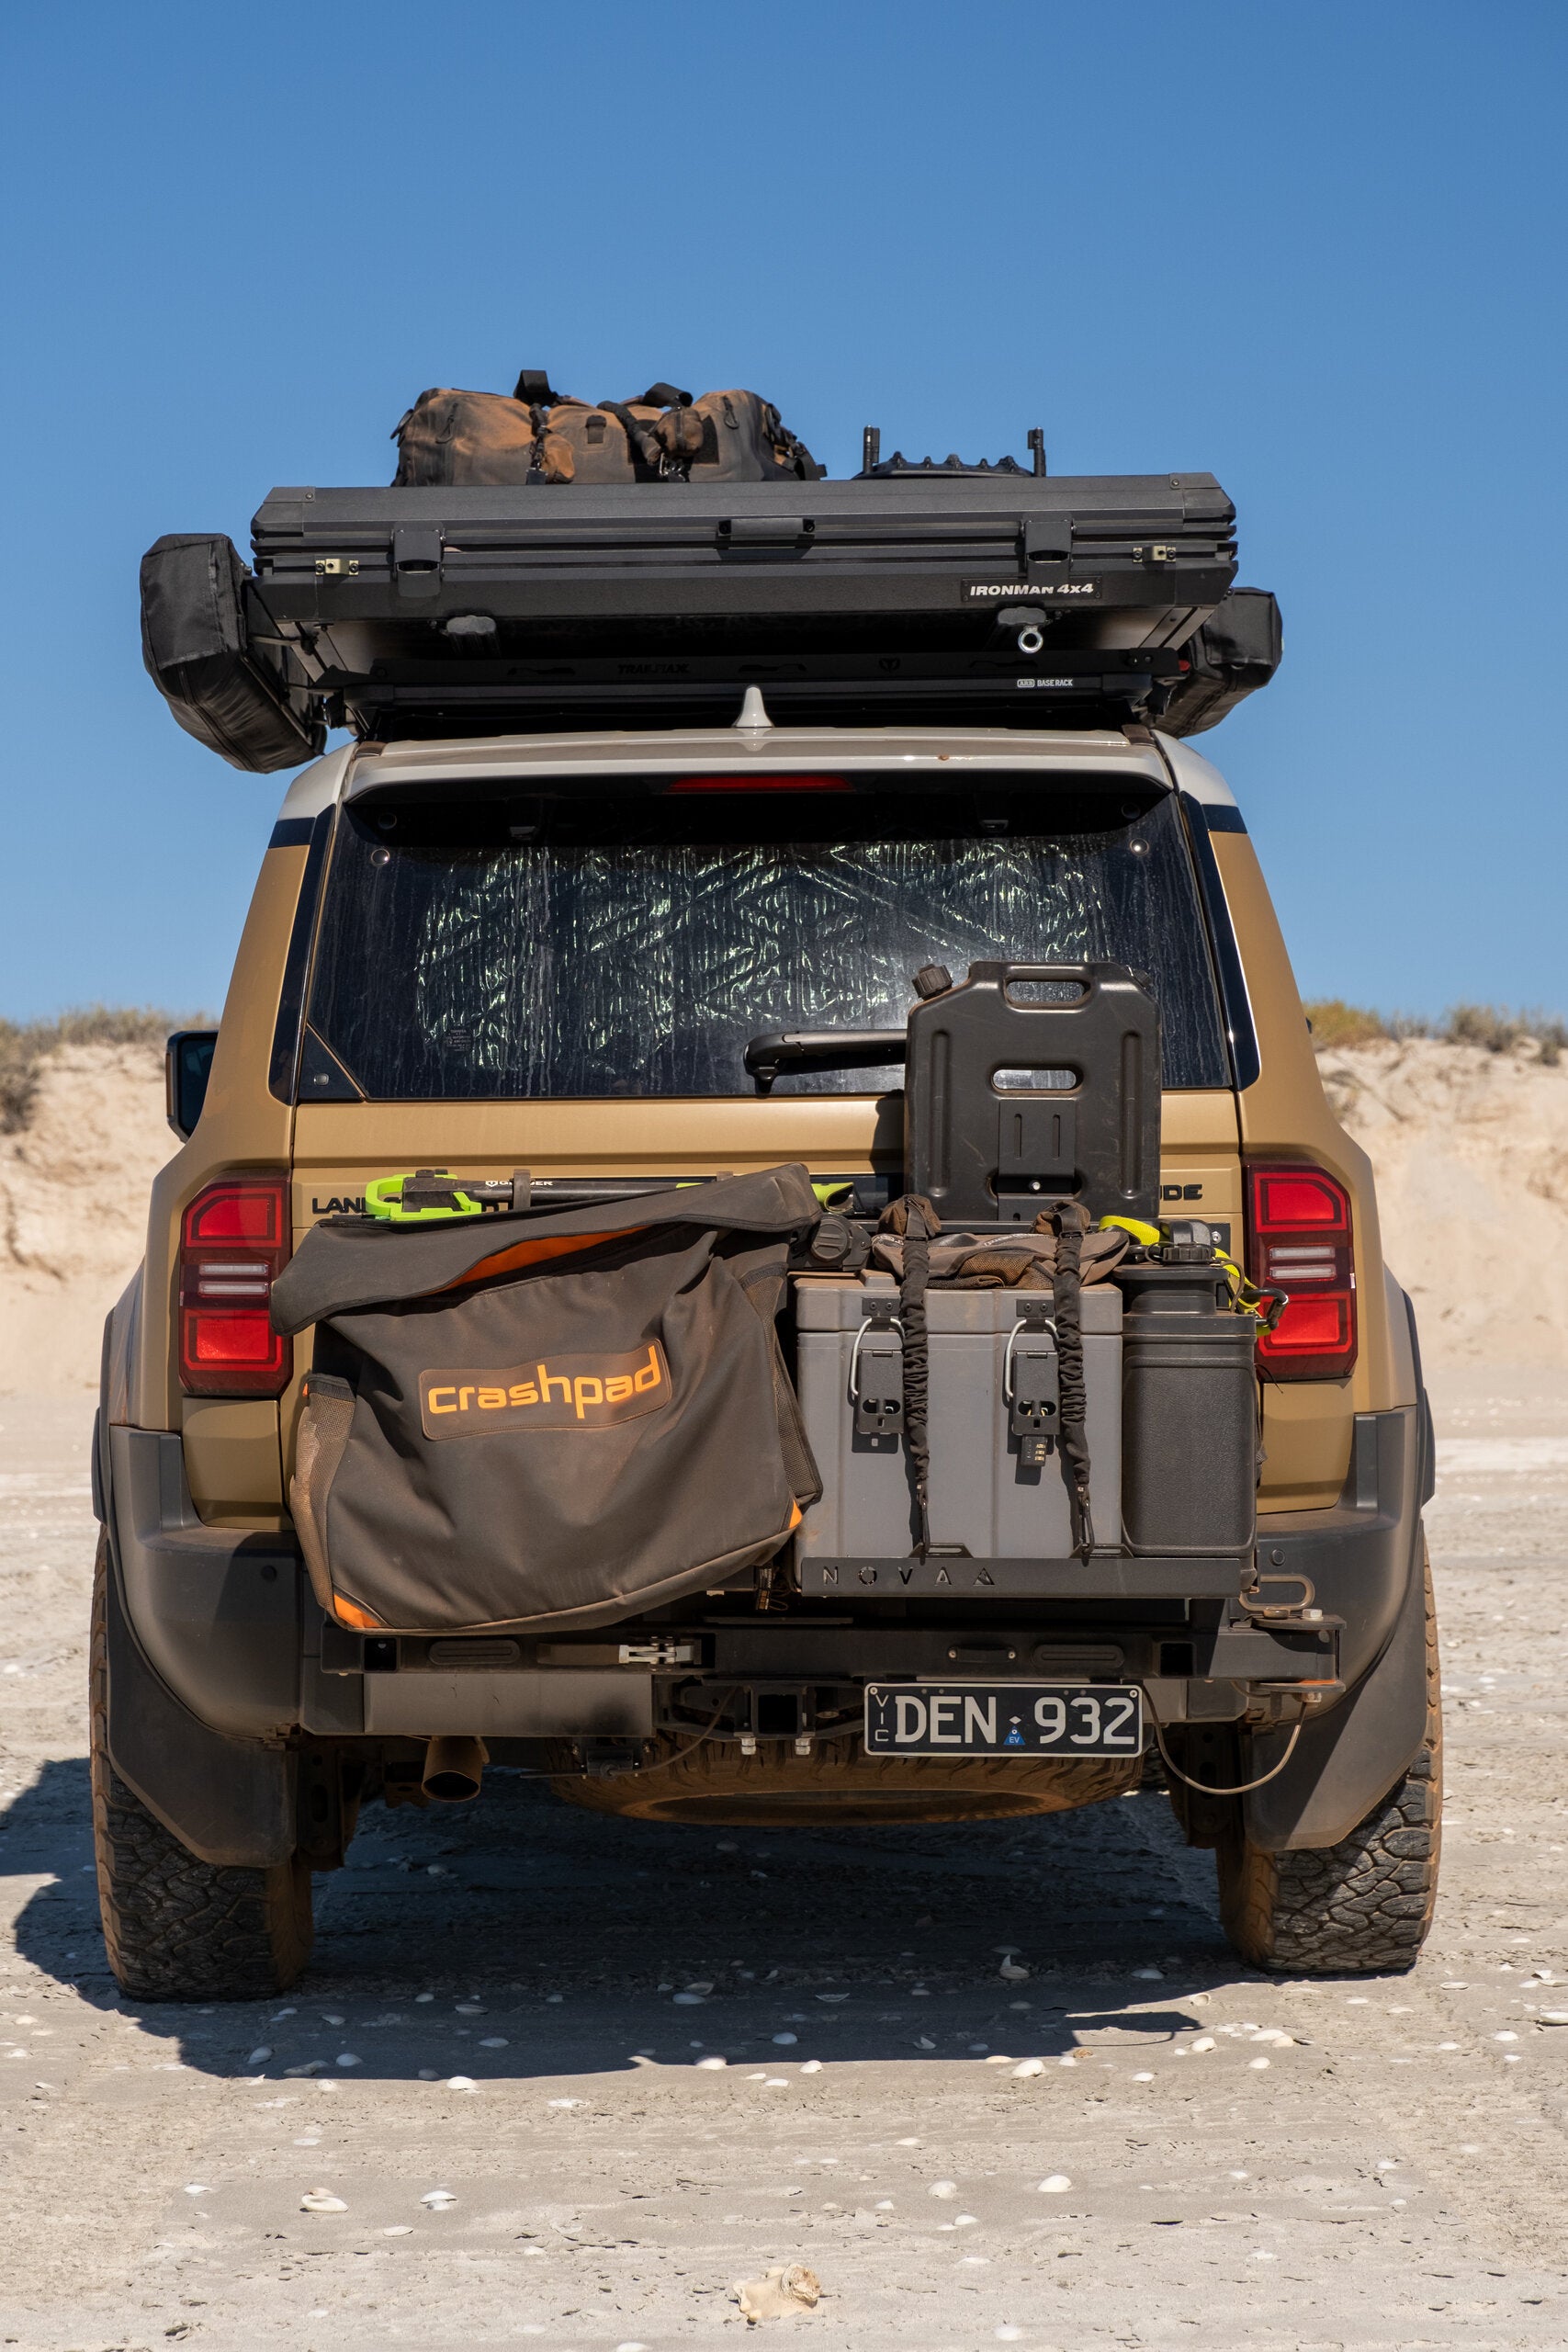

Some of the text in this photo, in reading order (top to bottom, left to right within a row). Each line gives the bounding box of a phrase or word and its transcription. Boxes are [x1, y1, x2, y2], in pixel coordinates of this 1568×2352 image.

[970, 582, 1094, 596] IRONMAN 4x4
[1037, 679, 1055, 687] BASE
[1055, 679, 1073, 687] RACK
[428, 1345, 661, 1419] crashpad
[875, 1694, 889, 1742] VIC
[895, 1695, 1135, 1745] DEN 932
